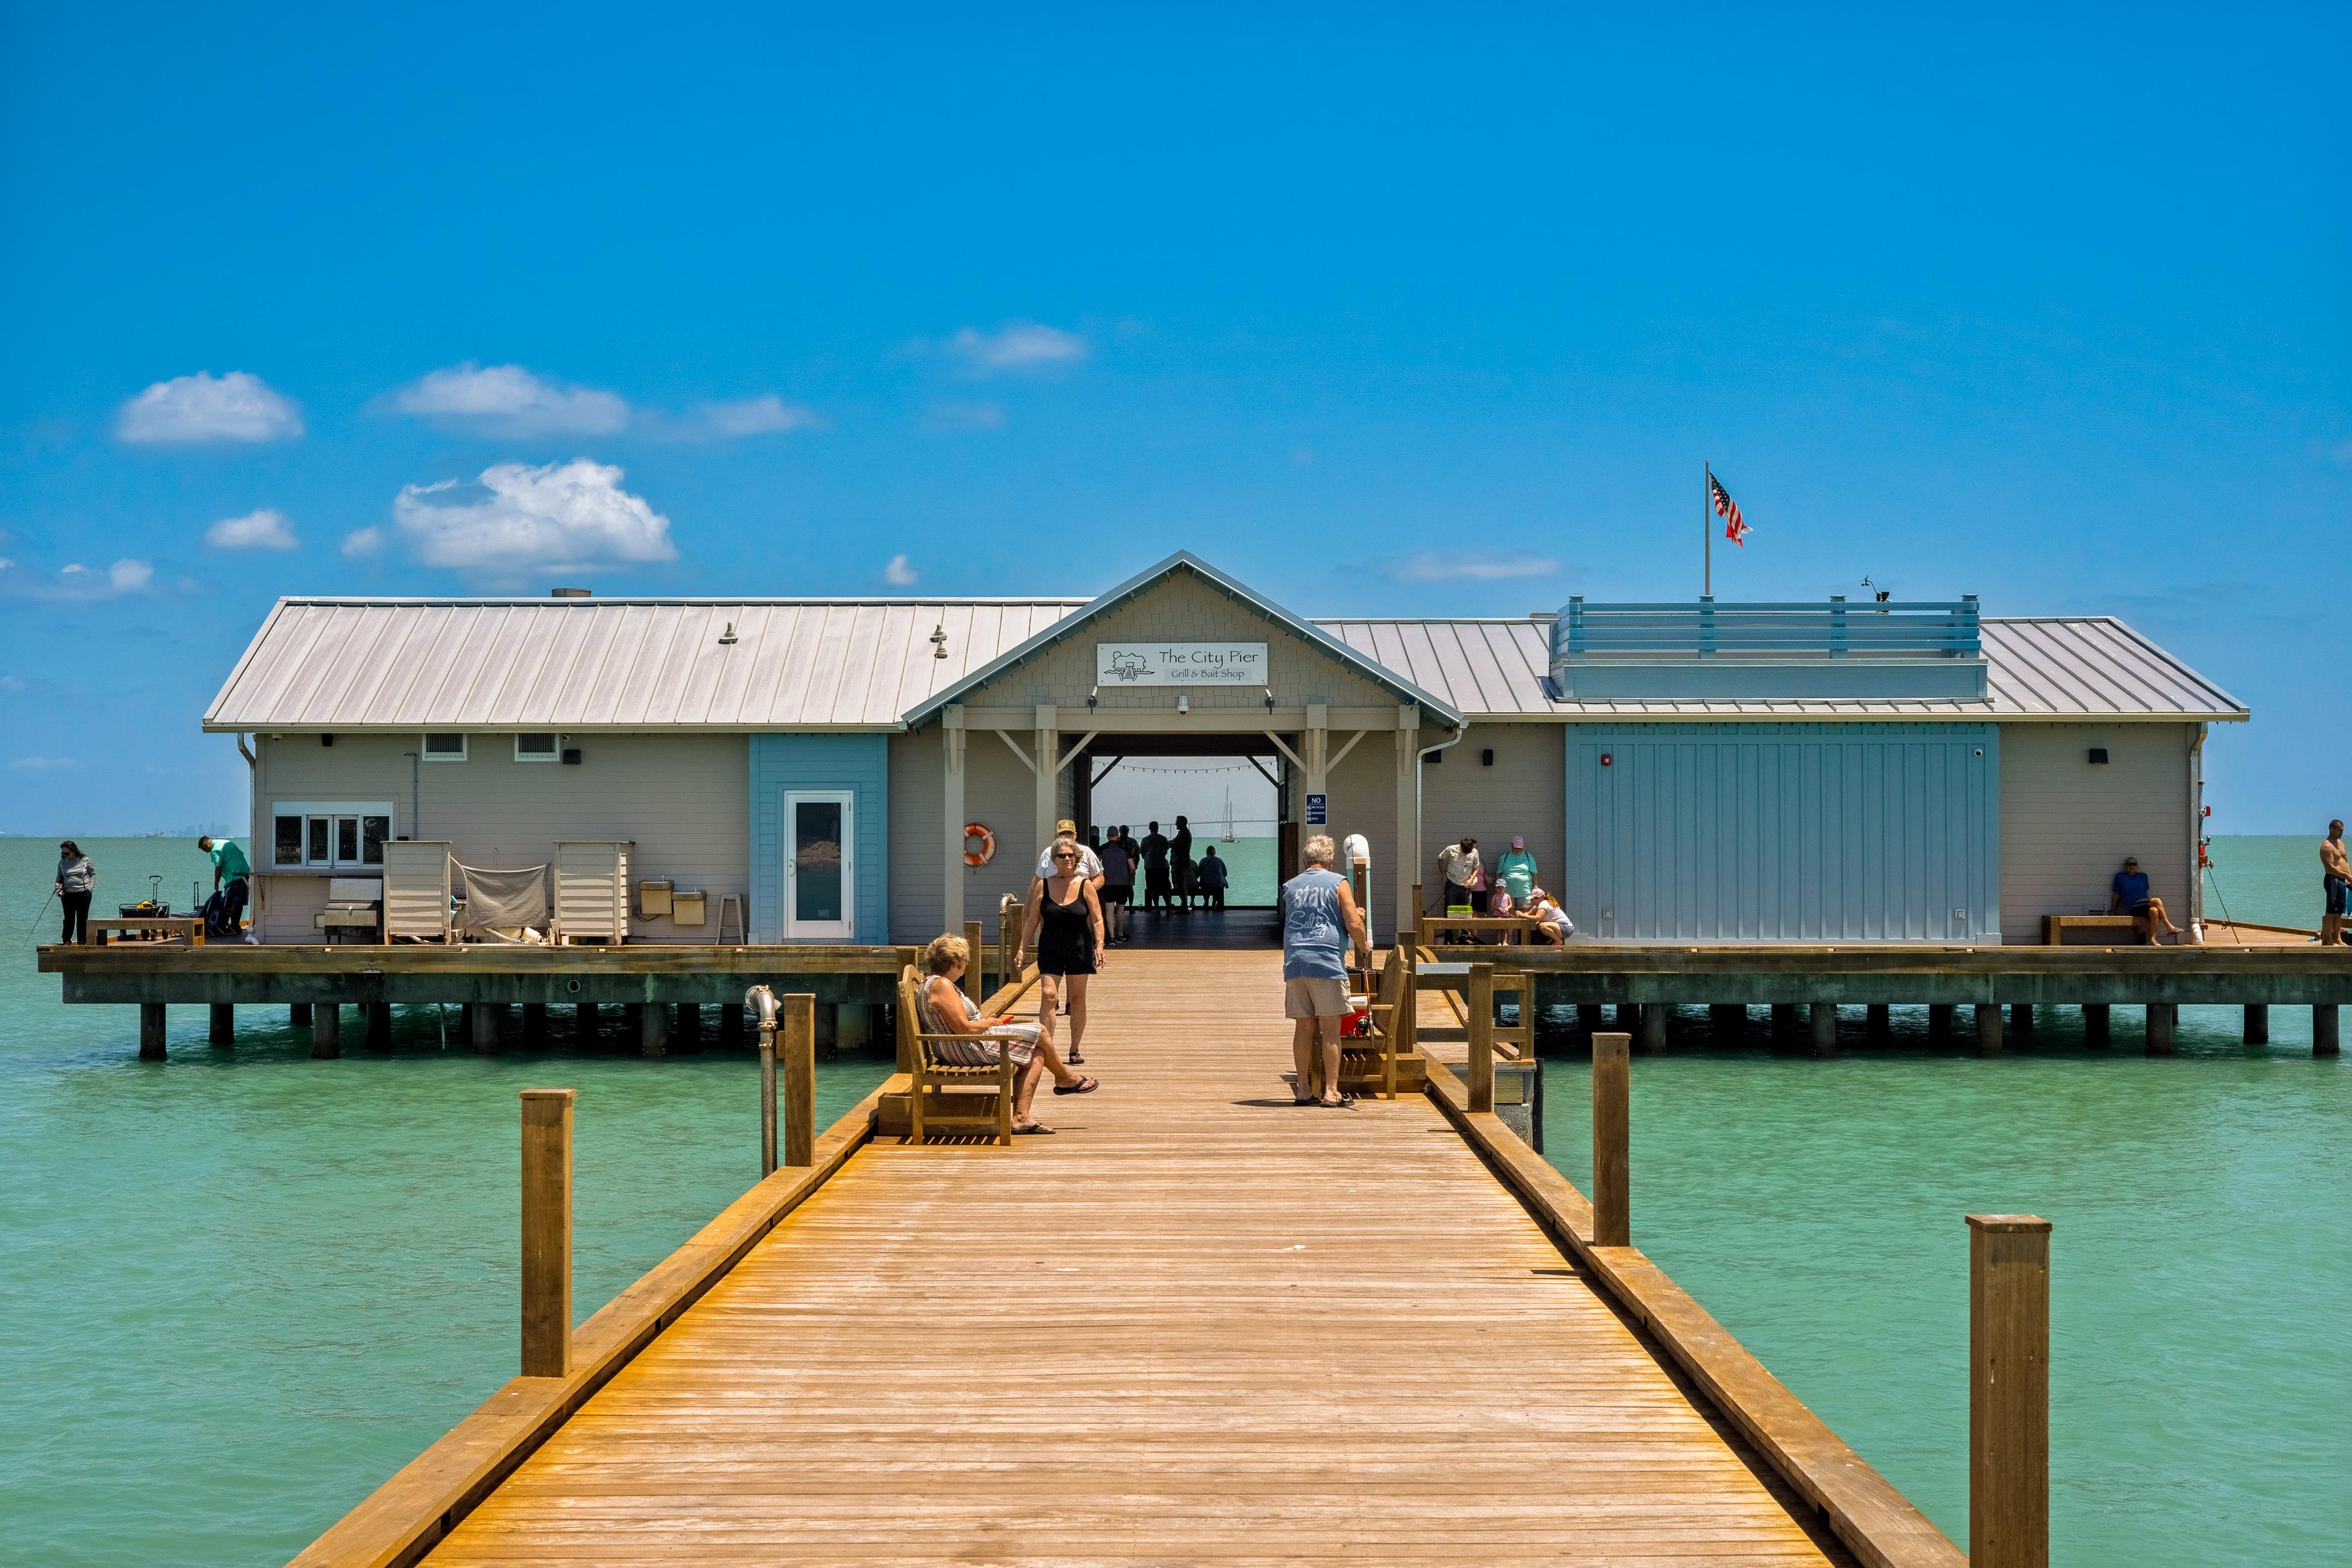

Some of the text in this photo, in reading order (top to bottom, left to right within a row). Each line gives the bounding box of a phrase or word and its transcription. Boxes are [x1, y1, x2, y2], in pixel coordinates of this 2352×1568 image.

[1159, 649, 1259, 669] The City Pier
[1172, 668, 1189, 677] Grill
[1221, 668, 1245, 680] Shop
[1294, 885, 1330, 912] stay
[1289, 911, 1327, 938] Salty
